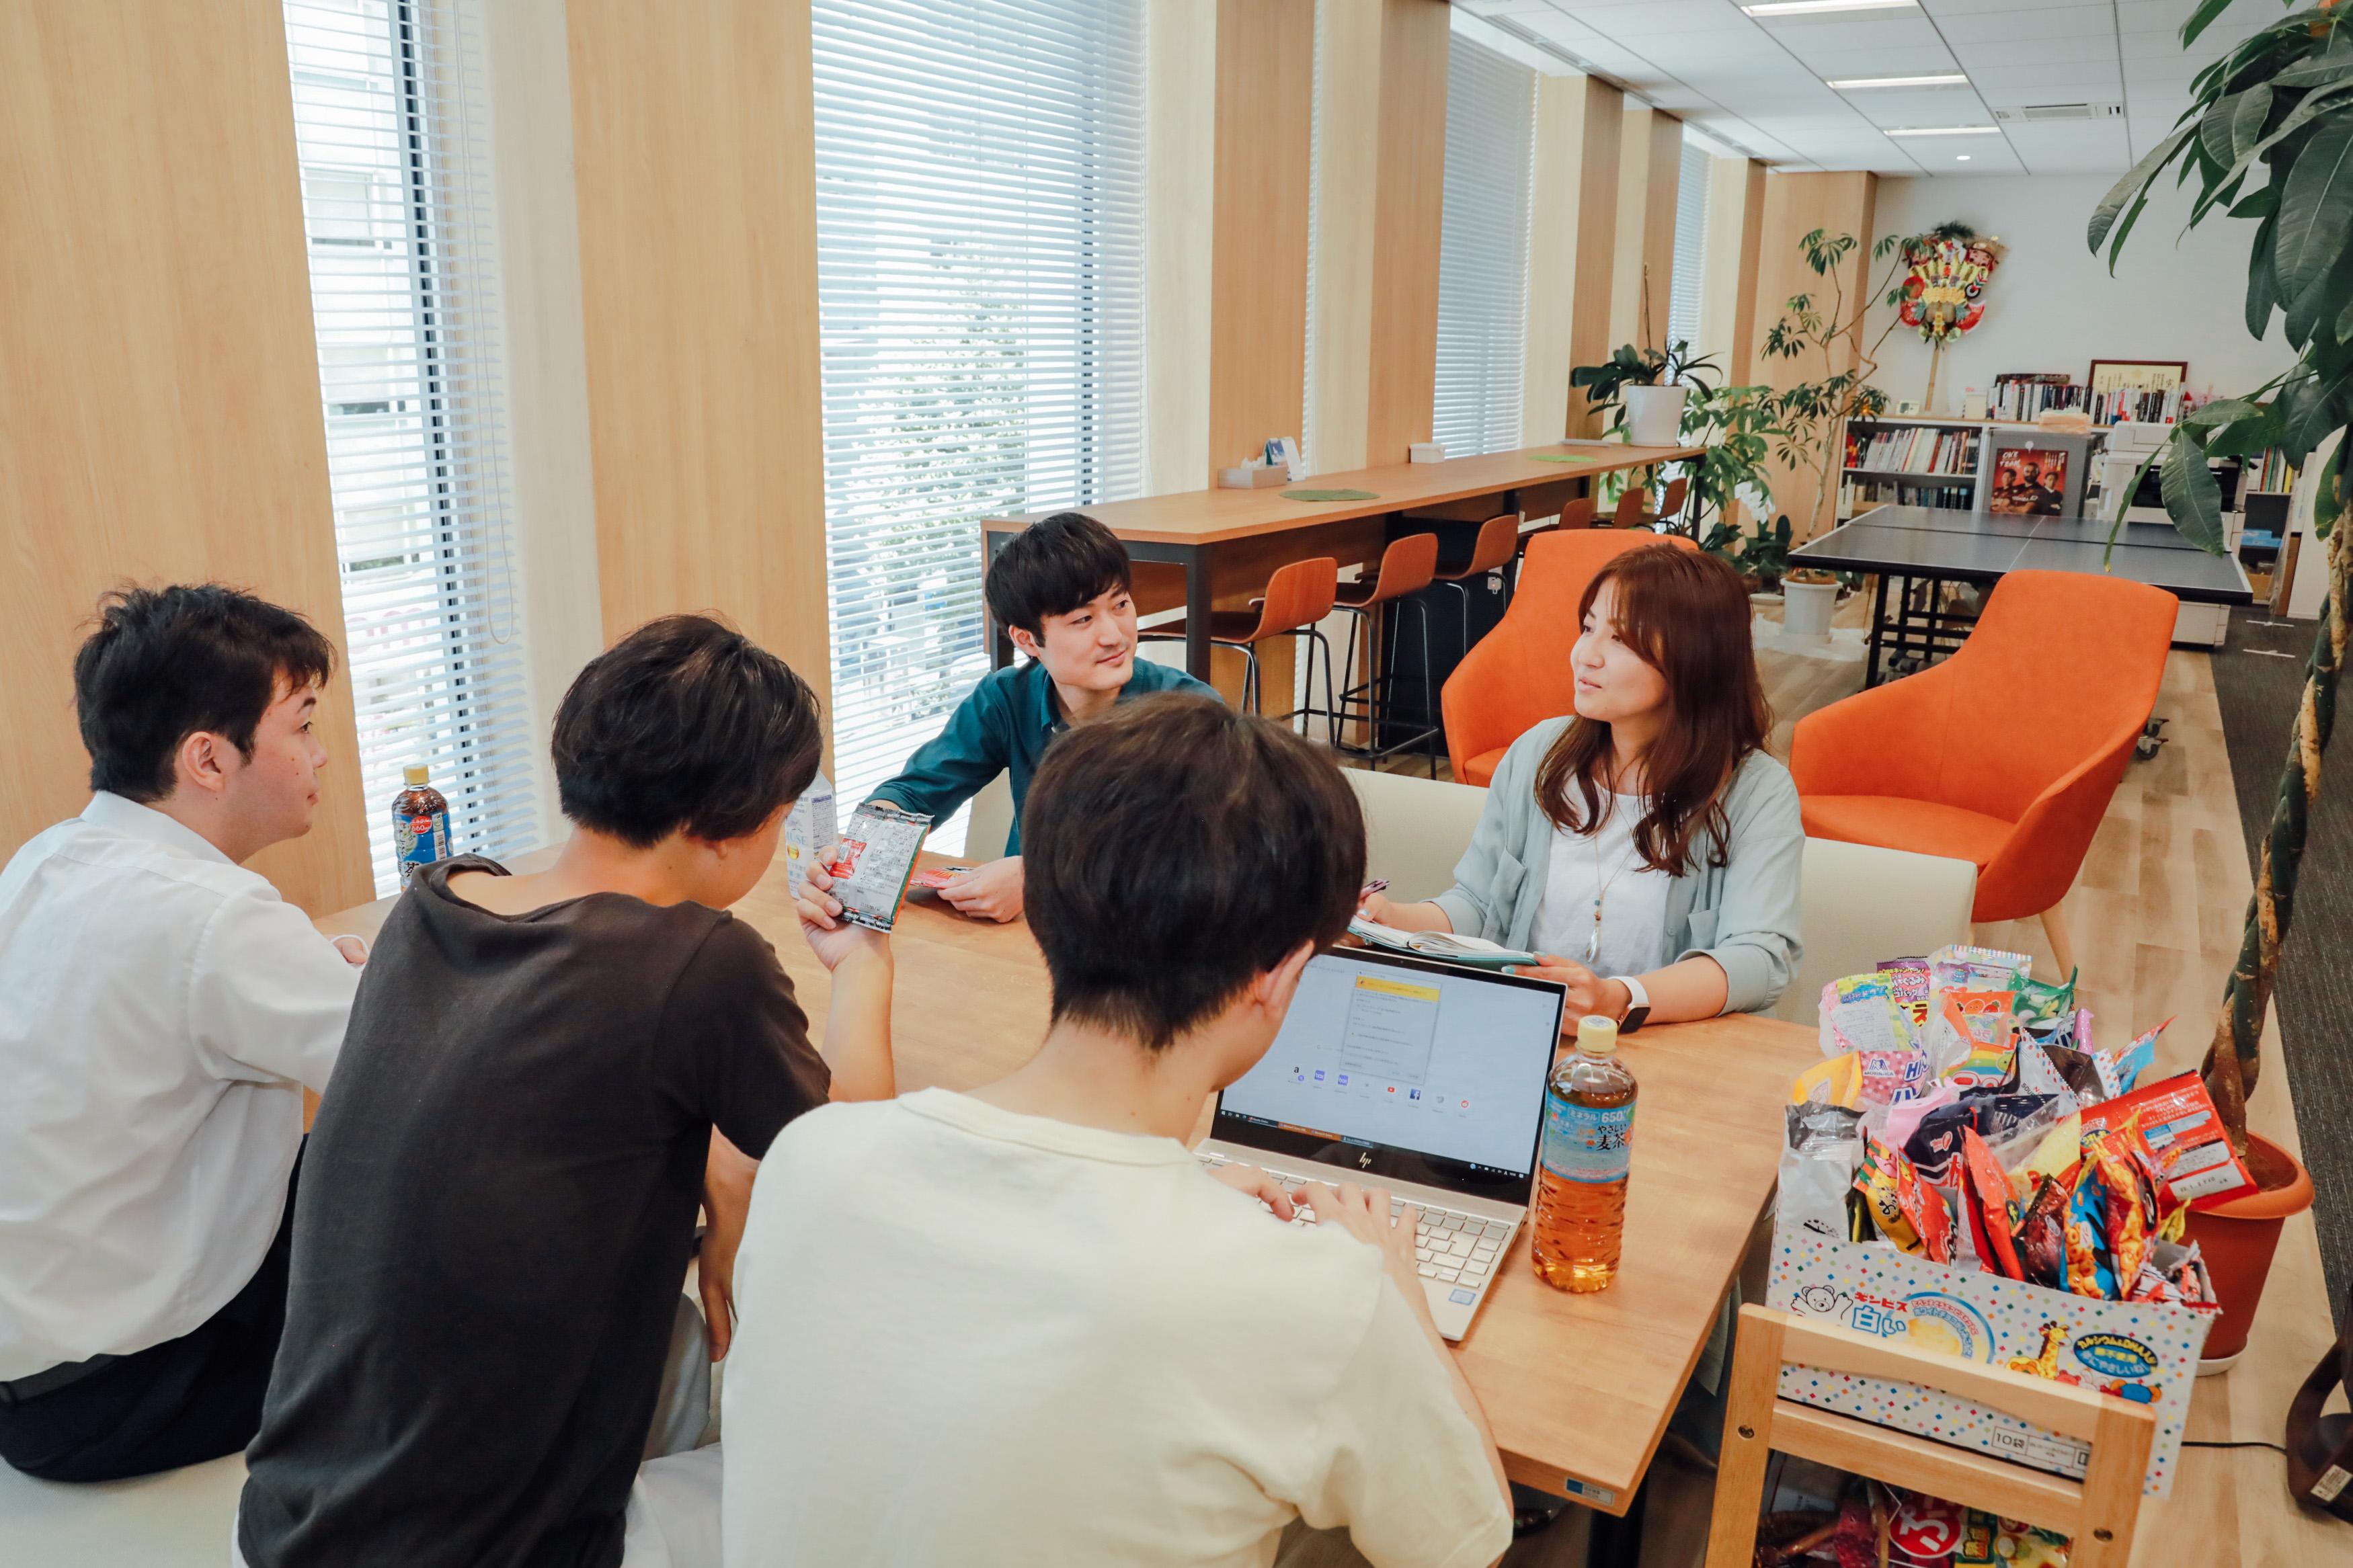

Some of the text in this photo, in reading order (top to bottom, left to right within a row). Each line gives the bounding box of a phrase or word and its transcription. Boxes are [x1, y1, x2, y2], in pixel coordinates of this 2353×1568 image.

[1597, 1124, 1626, 1134] やさしい
[1596, 1132, 1625, 1151] 麦茶
[1359, 1152, 1371, 1168] hp
[1854, 1291, 1908, 1313] ギンビス
[1852, 1305, 1906, 1334] 白い
